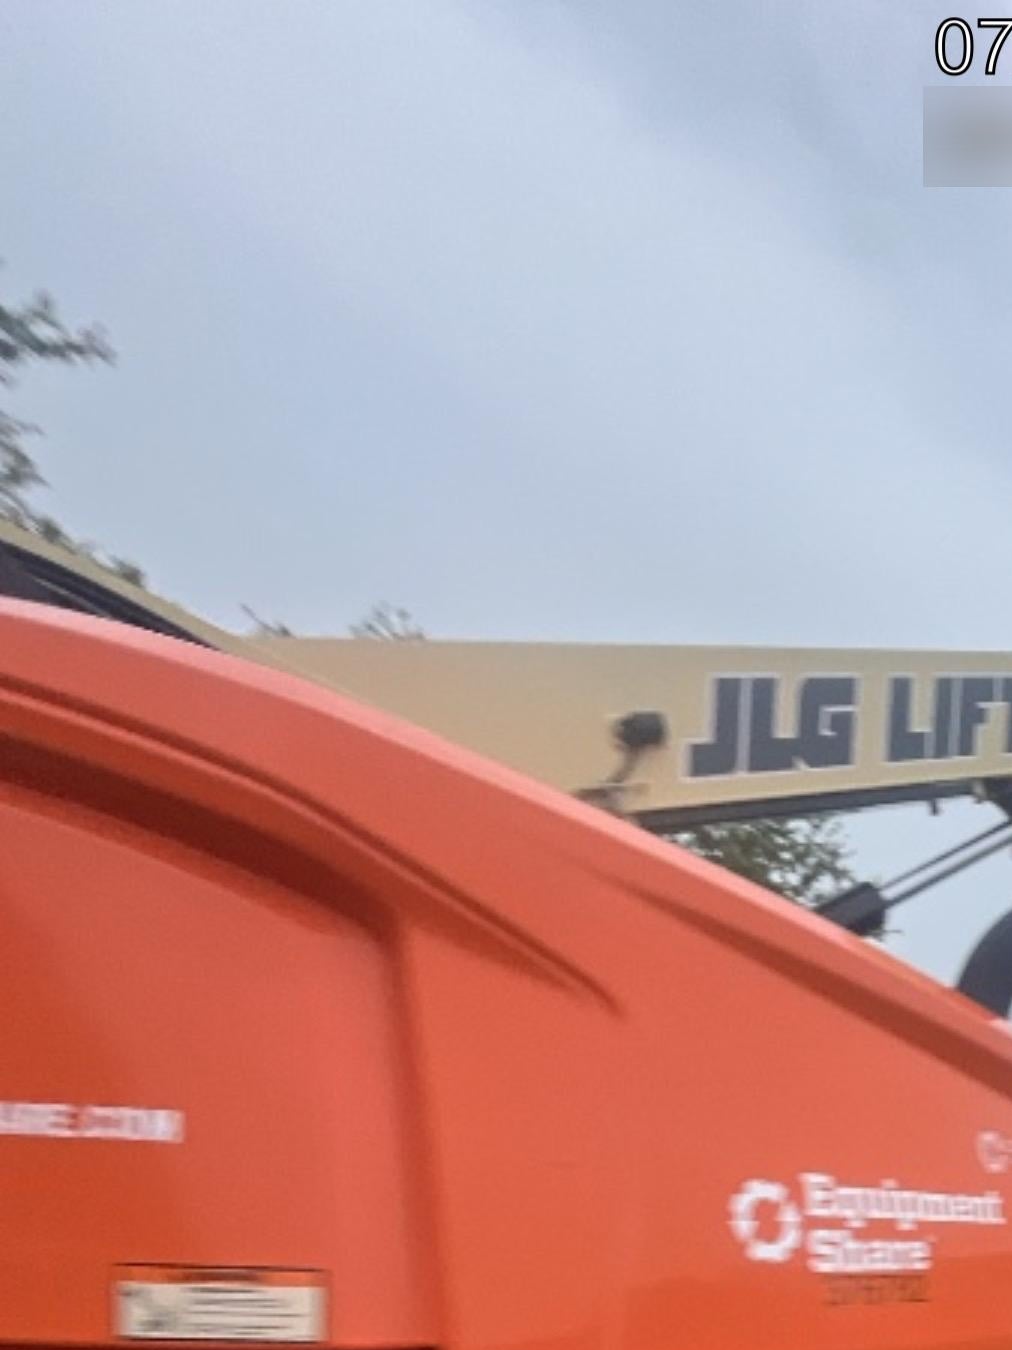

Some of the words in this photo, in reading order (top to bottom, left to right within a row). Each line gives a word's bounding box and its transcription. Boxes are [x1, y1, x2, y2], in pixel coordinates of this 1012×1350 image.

[683, 673, 859, 780] JLG
[801, 1172, 1006, 1231] Equipment
[807, 1229, 934, 1273] Share
